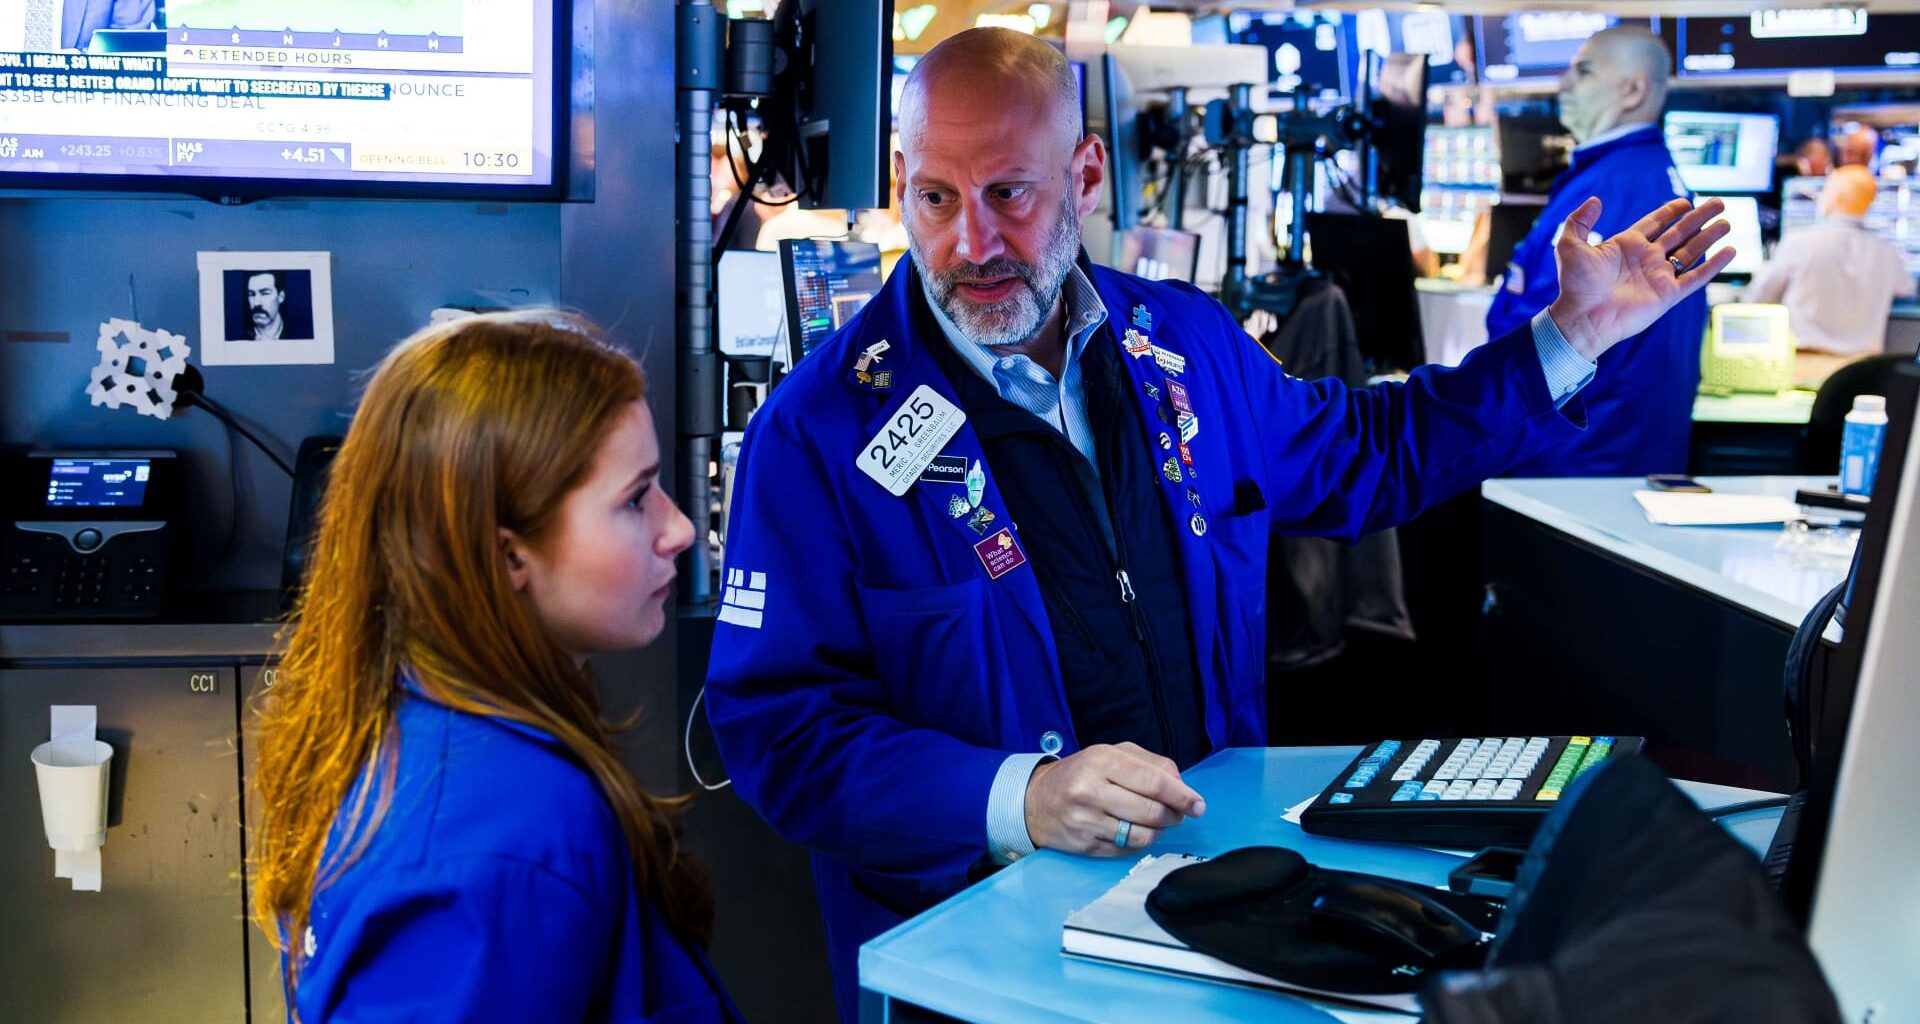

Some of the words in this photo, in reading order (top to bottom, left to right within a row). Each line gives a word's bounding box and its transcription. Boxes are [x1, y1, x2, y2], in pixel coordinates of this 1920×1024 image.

[180, 32, 188, 42] J
[231, 33, 240, 43] S
[284, 35, 294, 45] N
[333, 37, 341, 47] J
[377, 38, 388, 48] M
[428, 39, 439, 50] M
[71, 55, 87, 69] SO
[88, 56, 121, 71] WHAT
[122, 57, 155, 71] WHAT
[156, 58, 162, 71] I
[199, 49, 287, 62] EXTENDED
[295, 52, 352, 64] HOURS
[15, 73, 31, 87] TO
[32, 74, 55, 88] SEE
[56, 74, 68, 88] IS
[69, 75, 114, 90] BETTER
[162, 78, 198, 93] DON'T
[199, 79, 232, 93] WANT
[232, 79, 249, 94] TO
[322, 82, 339, 96] BY
[52, 90, 95, 104] CHIP
[103, 92, 209, 108] FINANCING
[217, 96, 265, 109] DEAL
[21, 148, 44, 158] JUN
[60, 143, 111, 157] +243.25
[176, 142, 203, 153] NAS
[281, 147, 325, 163] +4.51
[176, 152, 194, 163] FV
[359, 154, 414, 165] OPENING
[418, 155, 448, 165] BELL
[463, 152, 519, 167] 10:30
[870, 396, 934, 470] 2425
[889, 457, 908, 478] MERIC
[914, 411, 946, 448] GREENBAUM
[902, 463, 922, 484] CITADEL
[927, 463, 964, 474] Pearson
[985, 547, 1004, 560] What
[990, 550, 1013, 566] science
[993, 563, 1006, 572] can
[1005, 557, 1015, 565] do
[190, 674, 214, 692] CC1
